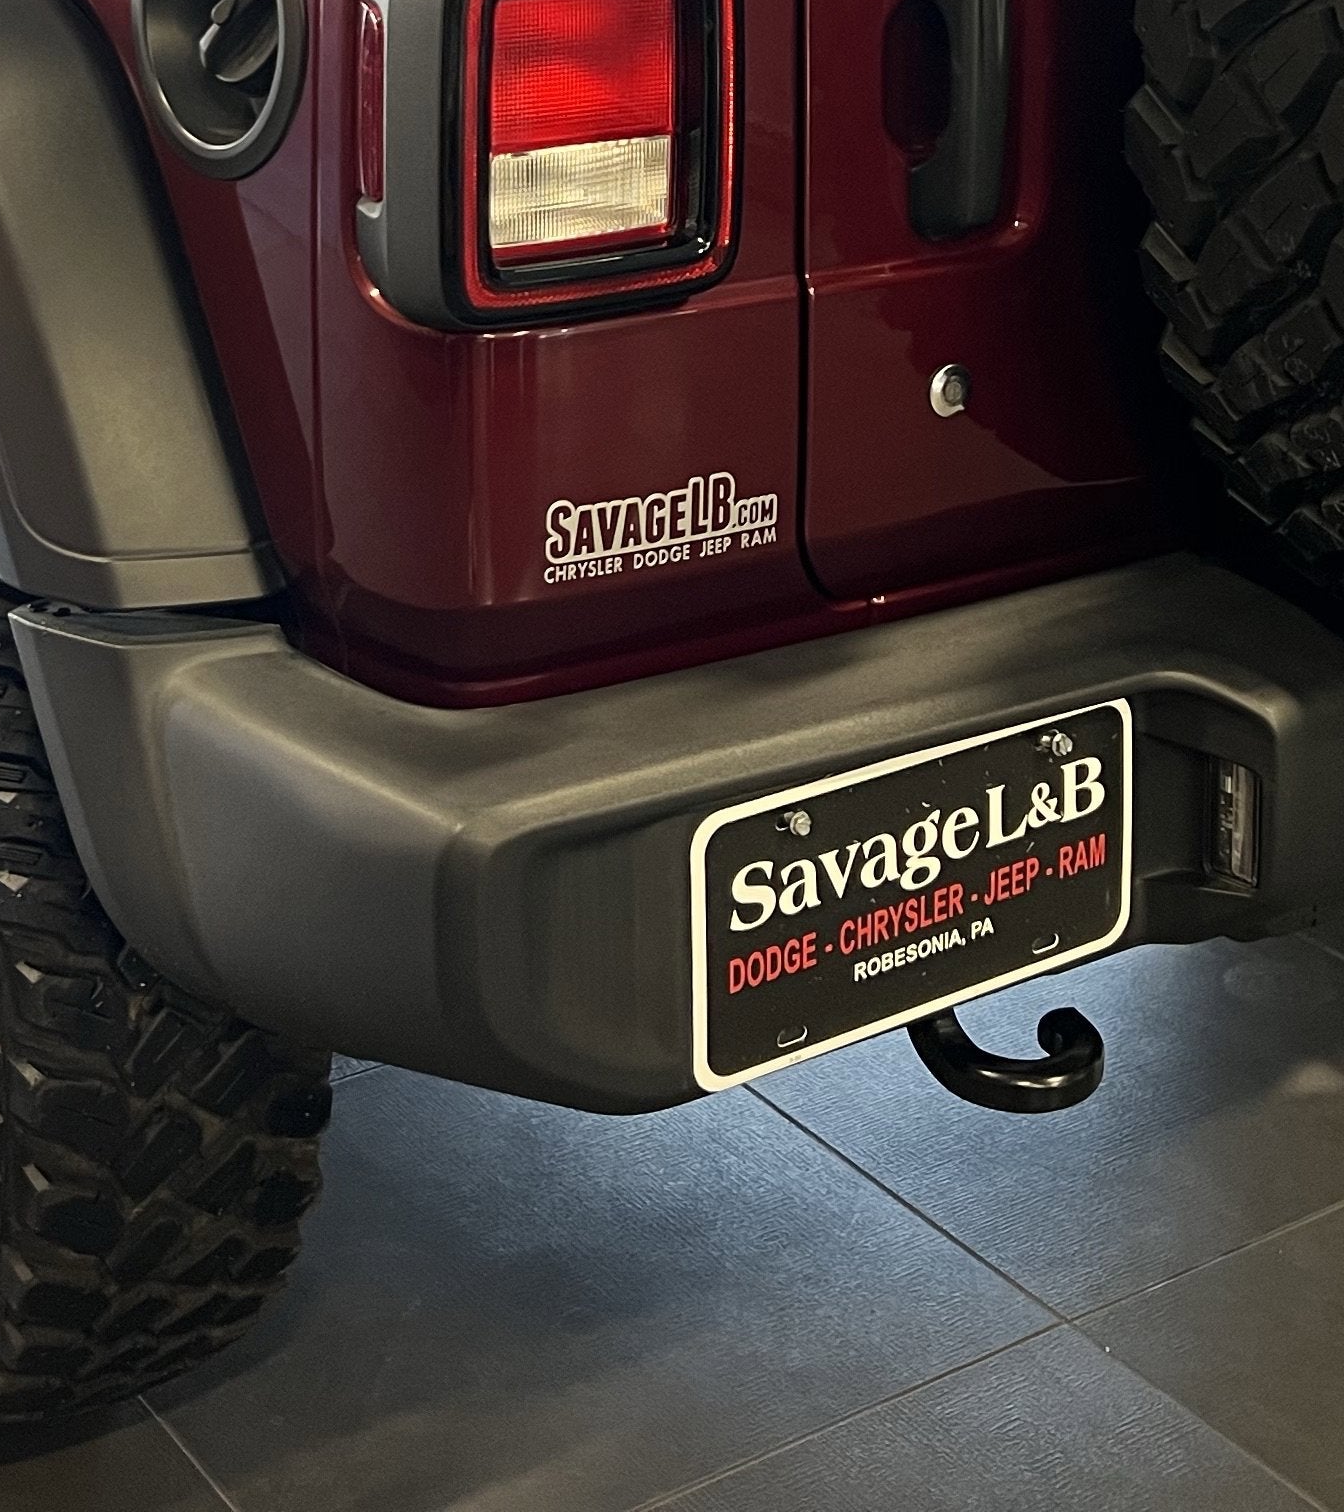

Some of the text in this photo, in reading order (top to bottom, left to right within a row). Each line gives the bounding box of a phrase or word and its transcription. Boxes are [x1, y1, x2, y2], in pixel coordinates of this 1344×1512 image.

[543, 527, 777, 584] CHRYSLER DODGE JEEP RAM
[729, 756, 1106, 932] SavageL&B
[728, 931, 818, 995] DODGE
[839, 883, 964, 955] CHRYSLER
[983, 857, 1040, 906] JEEP
[1059, 833, 1106, 879] RAM
[853, 917, 995, 982] ROBESONIA, PA
